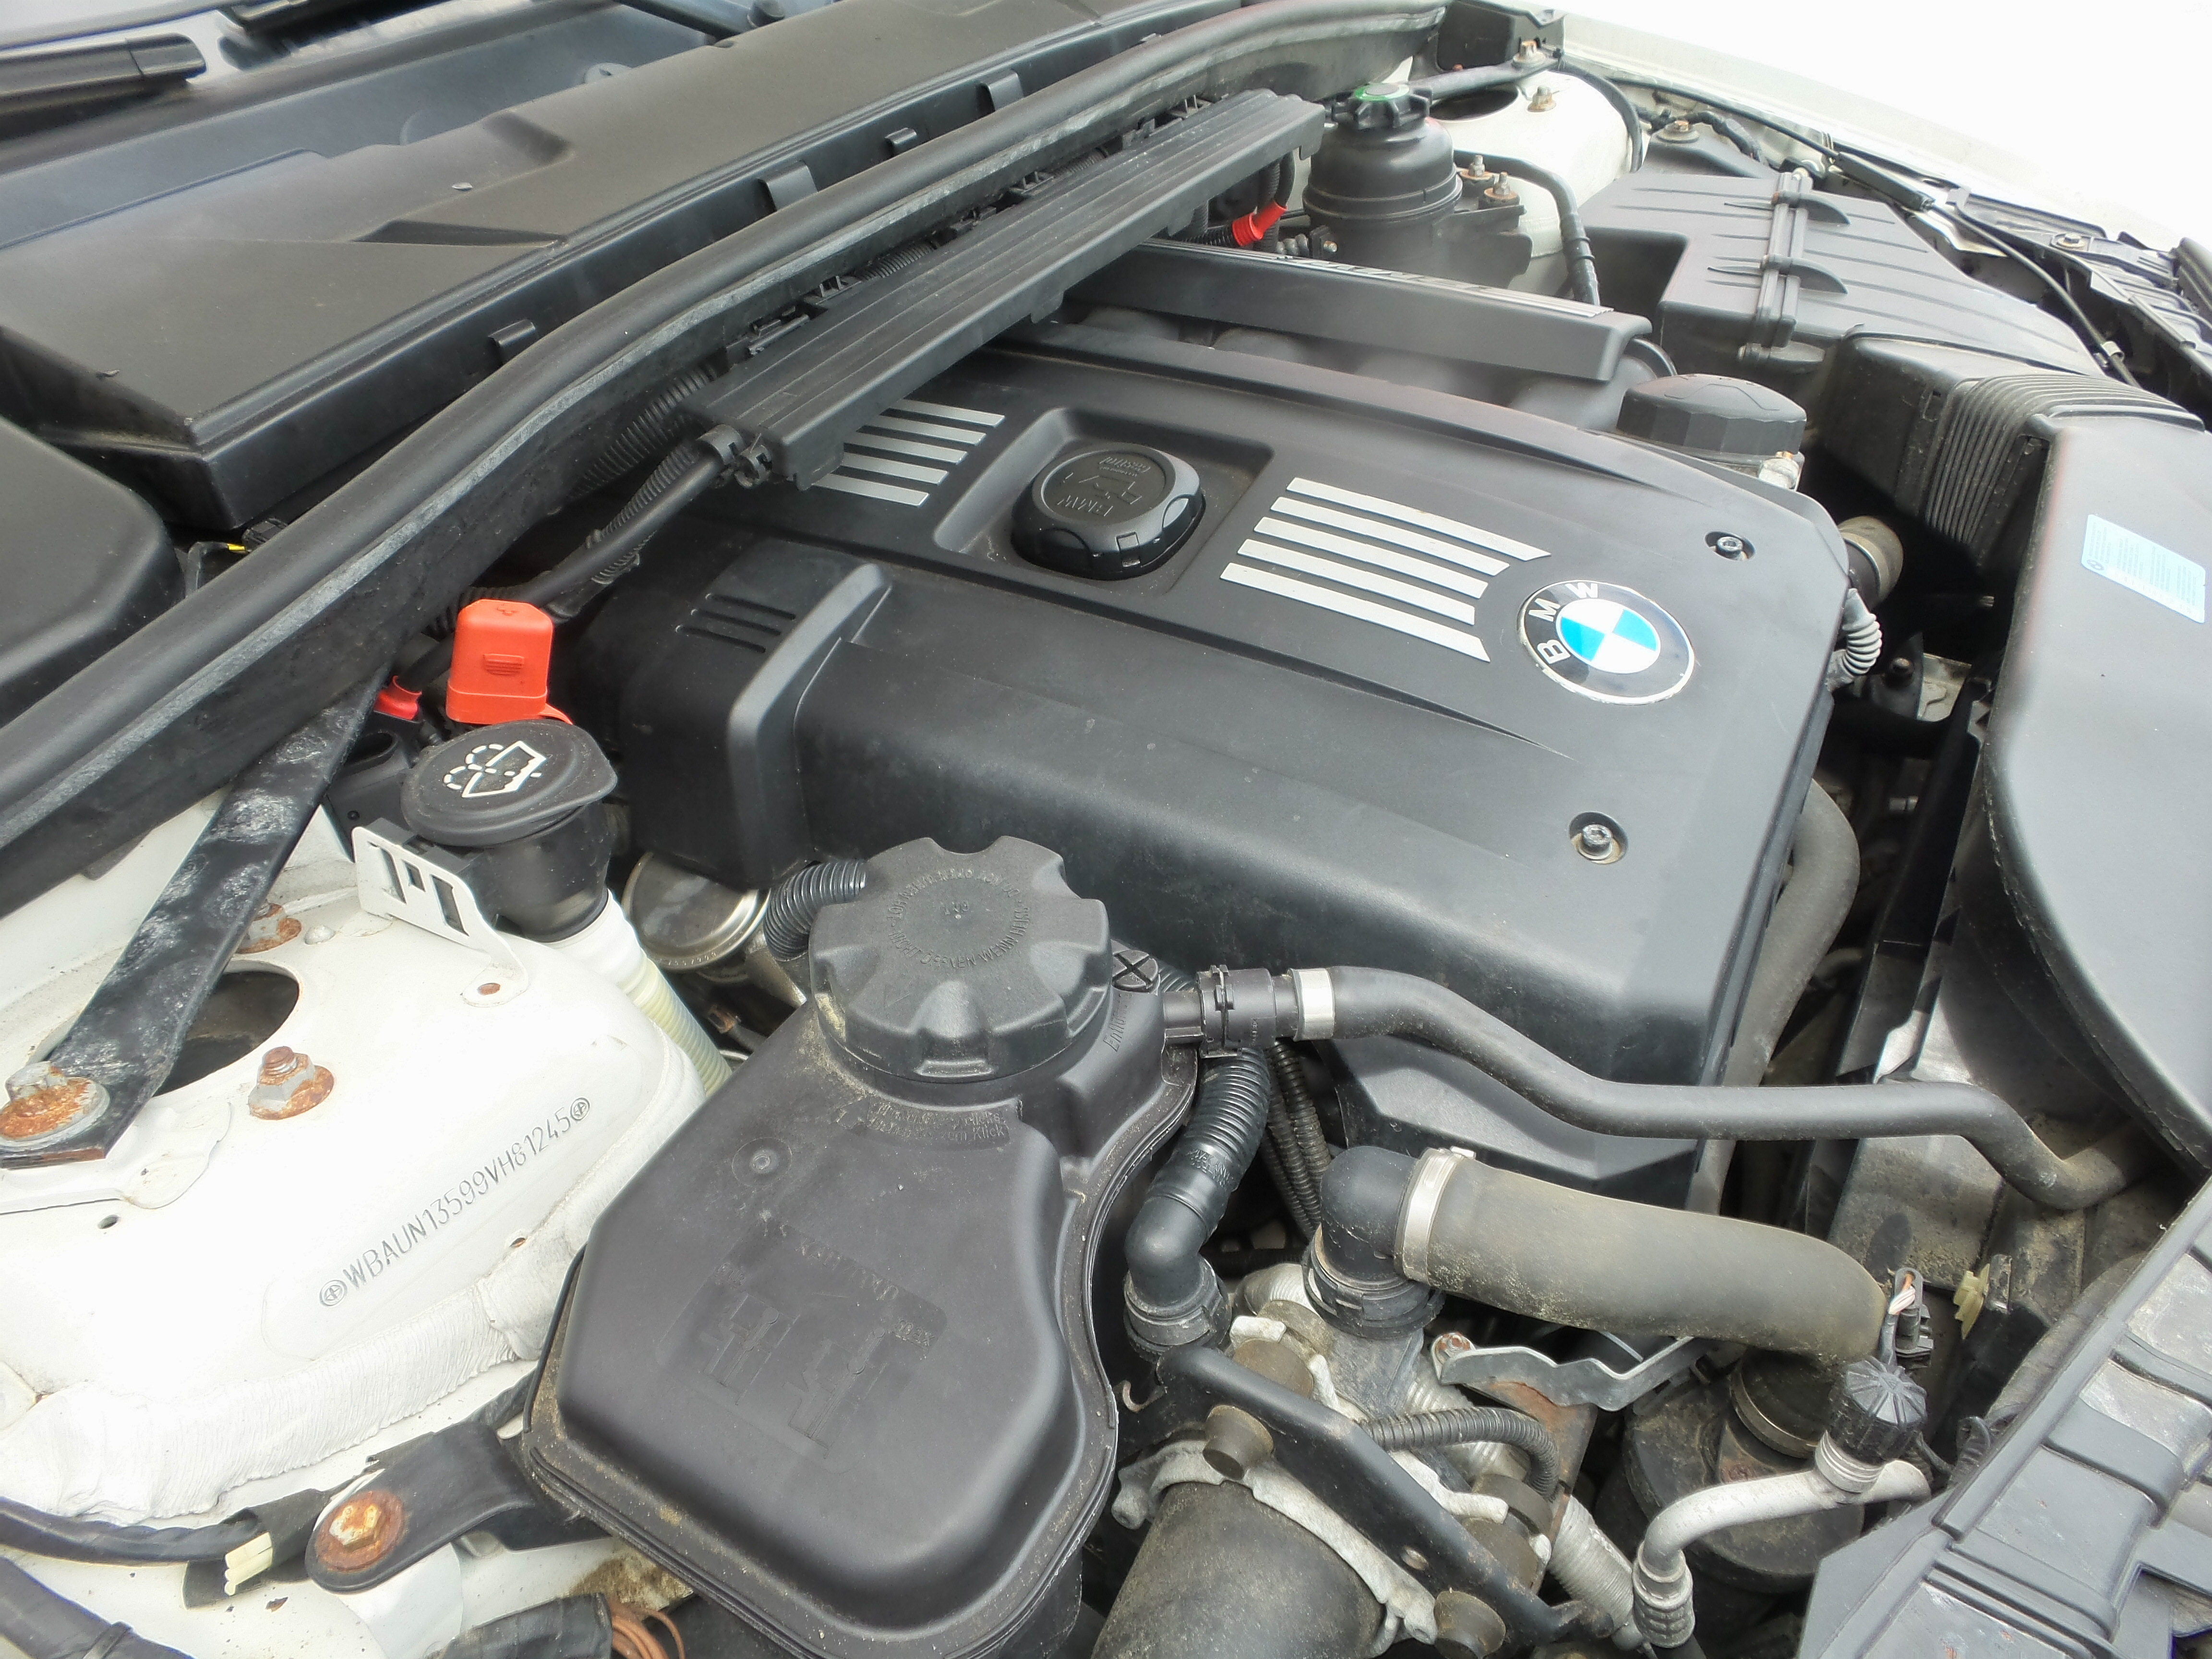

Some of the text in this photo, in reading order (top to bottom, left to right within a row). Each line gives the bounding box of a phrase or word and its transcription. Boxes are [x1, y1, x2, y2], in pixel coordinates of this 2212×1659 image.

[1528, 582, 1598, 664] BMW
[888, 929, 923, 958] NICHT
[978, 935, 1019, 962] WENN
[973, 1124, 1005, 1141] Klick
[343, 1107, 571, 1289] WBAUN13599VH81245
